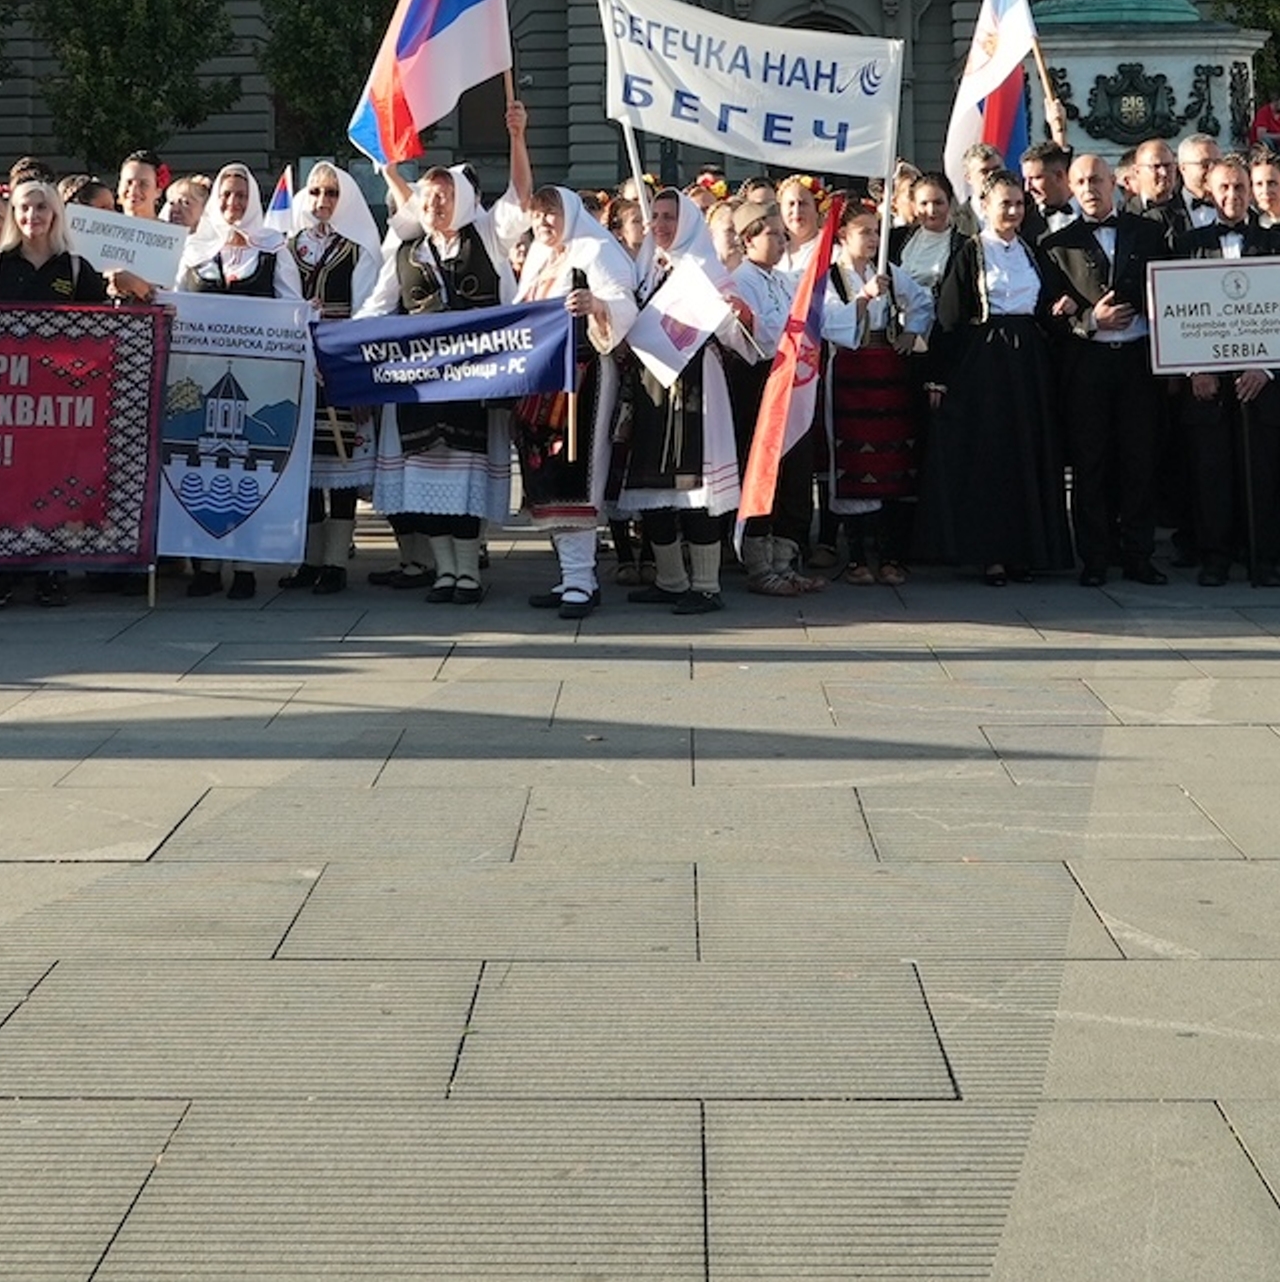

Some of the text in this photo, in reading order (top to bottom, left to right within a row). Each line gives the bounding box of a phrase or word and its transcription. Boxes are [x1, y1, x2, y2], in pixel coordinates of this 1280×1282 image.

[611, 5, 838, 94] БЕГЕЧКА НАН
[622, 72, 850, 153] БЕГЕЧ
[70, 217, 86, 233] КУД
[1163, 302, 1212, 318] АНИП
[208, 323, 264, 336] KOZARSKA
[266, 327, 308, 340] DUBICA
[1180, 320, 1227, 331] Ensemble
[1230, 320, 1240, 330] of
[1240, 319, 1258, 329] folk
[1181, 329, 1202, 339] and
[1203, 329, 1231, 340] songs
[211, 337, 264, 350] КОЗАРСКА
[264, 340, 307, 354] ДУБИЦА
[361, 327, 534, 364] КУД ДУБИЧАНКЕ
[1212, 343, 1269, 359] SERBIA
[373, 365, 441, 384] Козарска
[443, 361, 498, 382] Дубица
